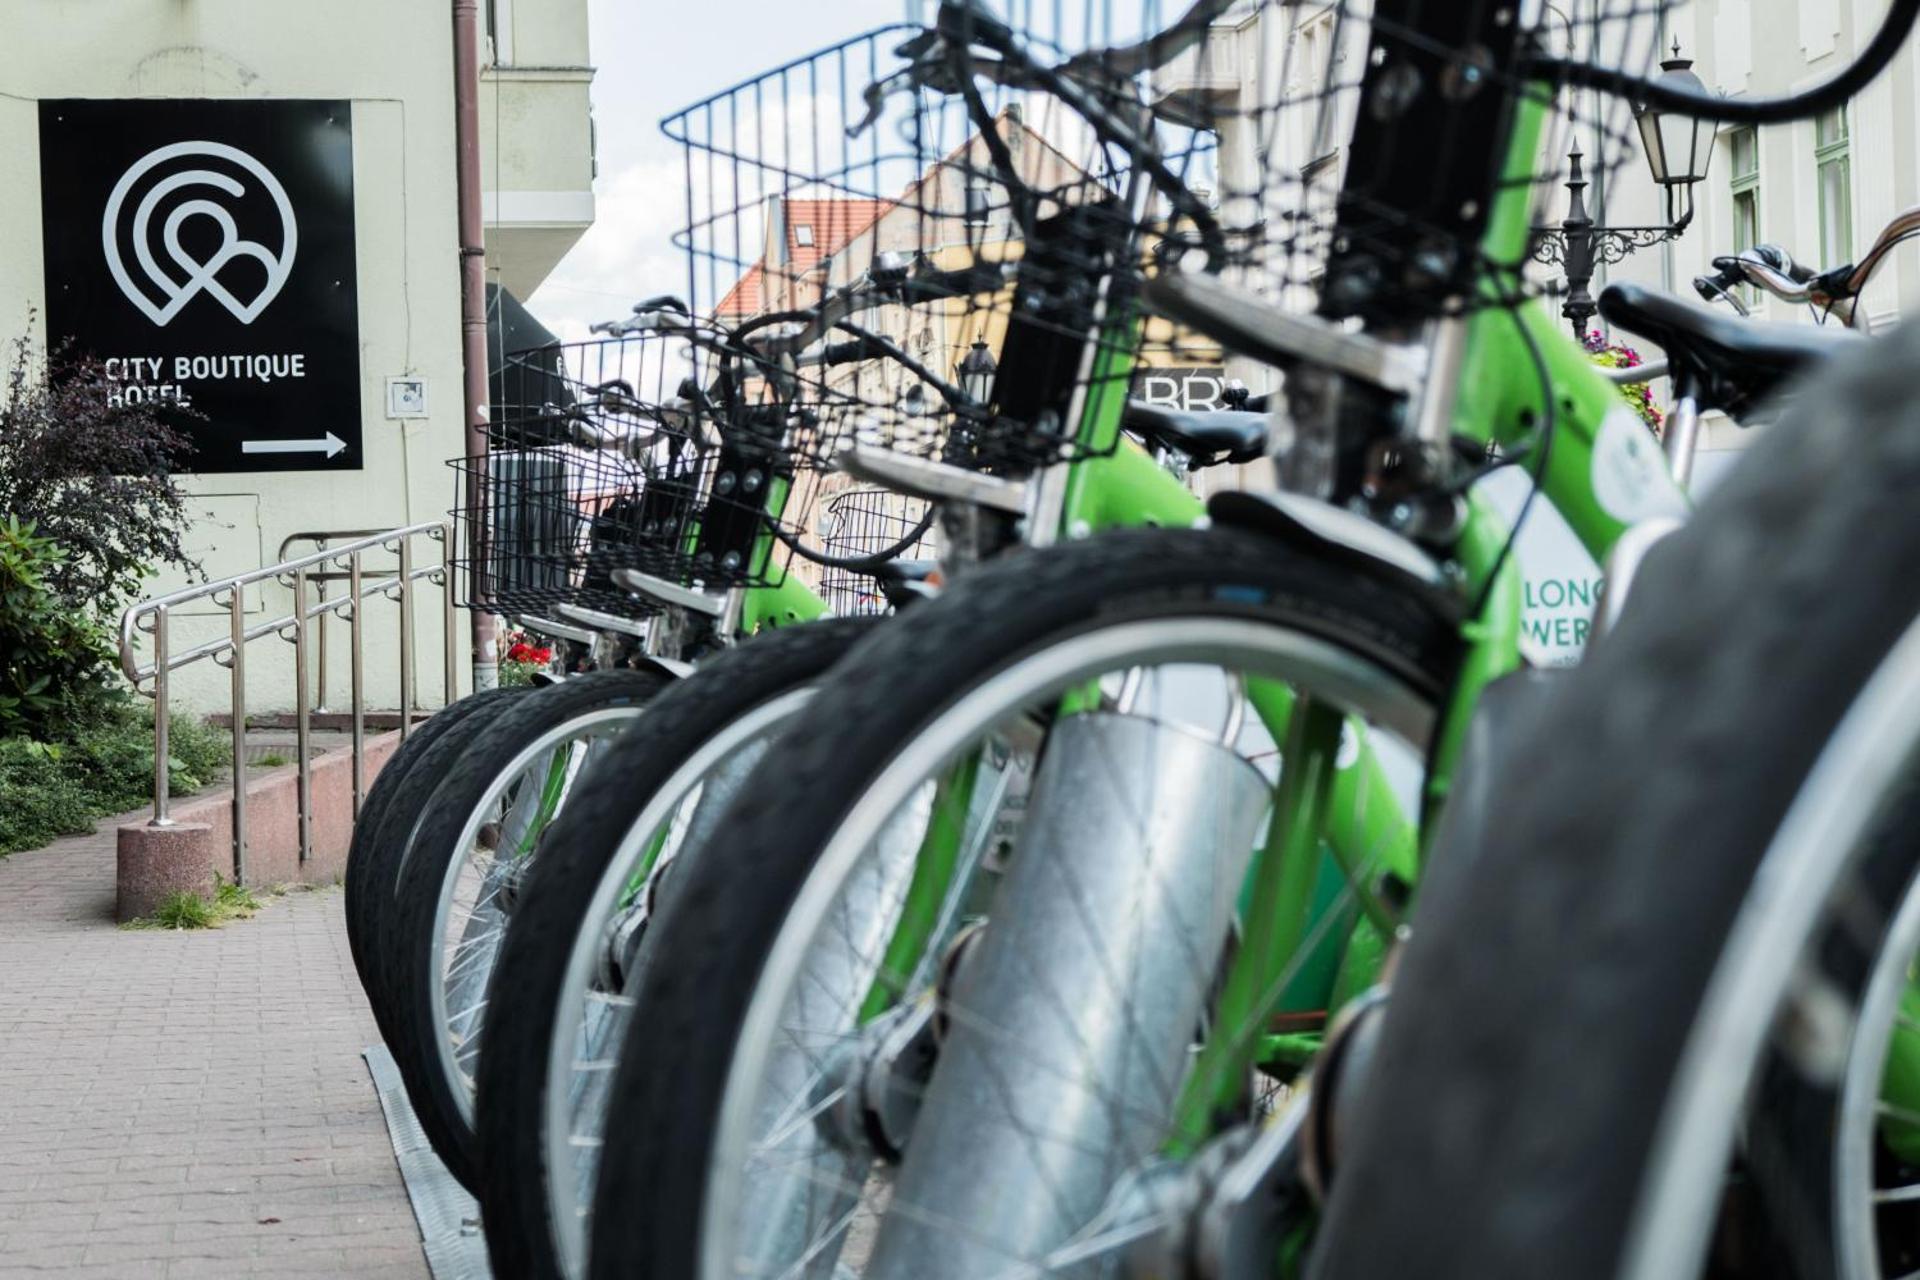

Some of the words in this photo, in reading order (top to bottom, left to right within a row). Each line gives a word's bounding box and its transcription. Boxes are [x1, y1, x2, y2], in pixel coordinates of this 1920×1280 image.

[105, 357, 163, 380] CITY
[174, 354, 306, 383] BOUTIQUE
[1145, 376, 1227, 412] BR
